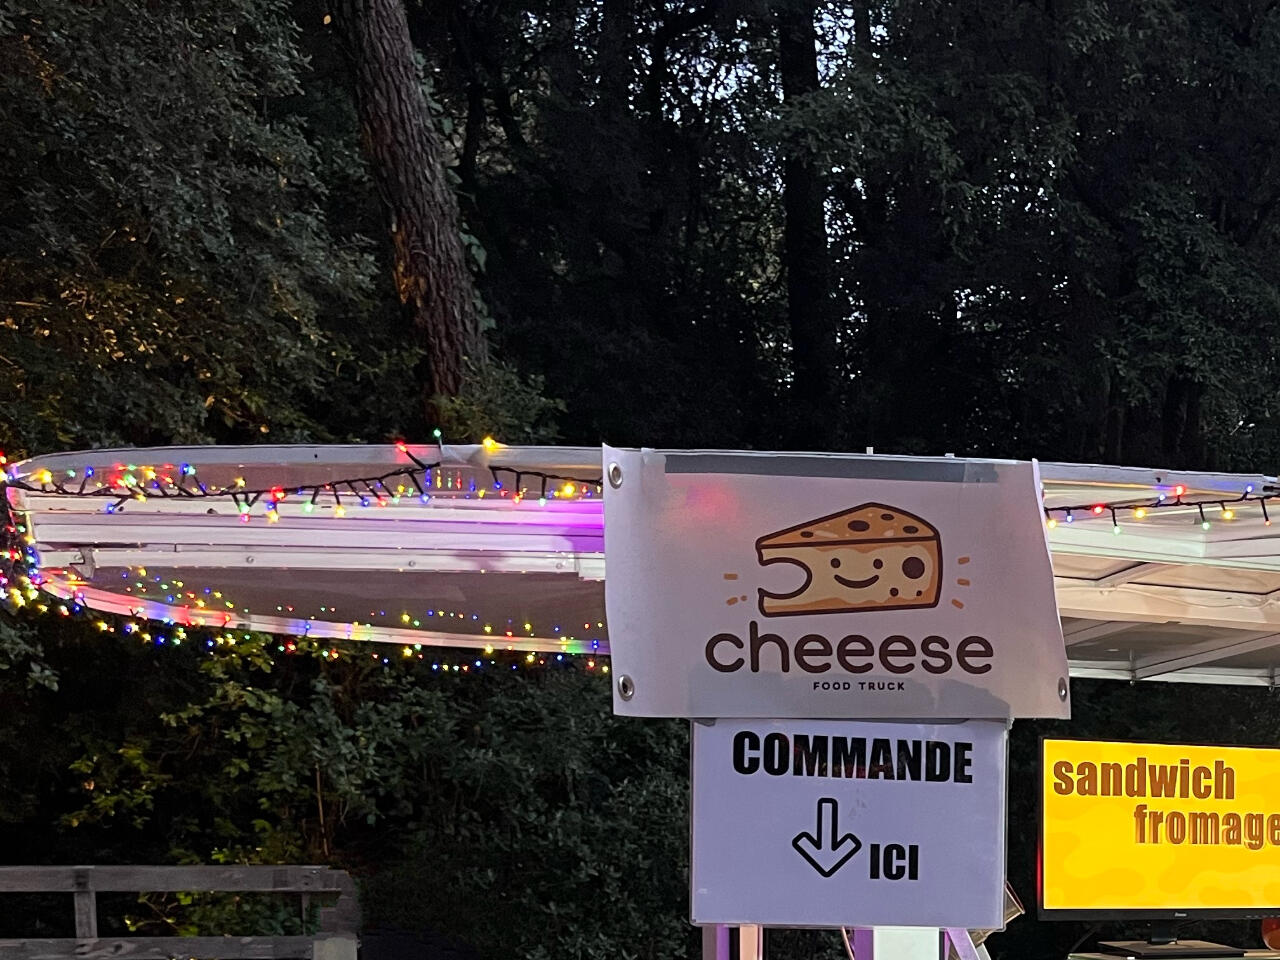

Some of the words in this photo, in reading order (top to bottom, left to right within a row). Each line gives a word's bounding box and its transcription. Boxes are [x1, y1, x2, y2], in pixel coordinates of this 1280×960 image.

[704, 621, 994, 675] cheeese
[813, 681, 851, 691] FOOD
[858, 681, 905, 691] TRUCK
[732, 730, 973, 784] COMMANDE
[1053, 757, 1235, 800] sandwich
[869, 843, 919, 880] ICI
